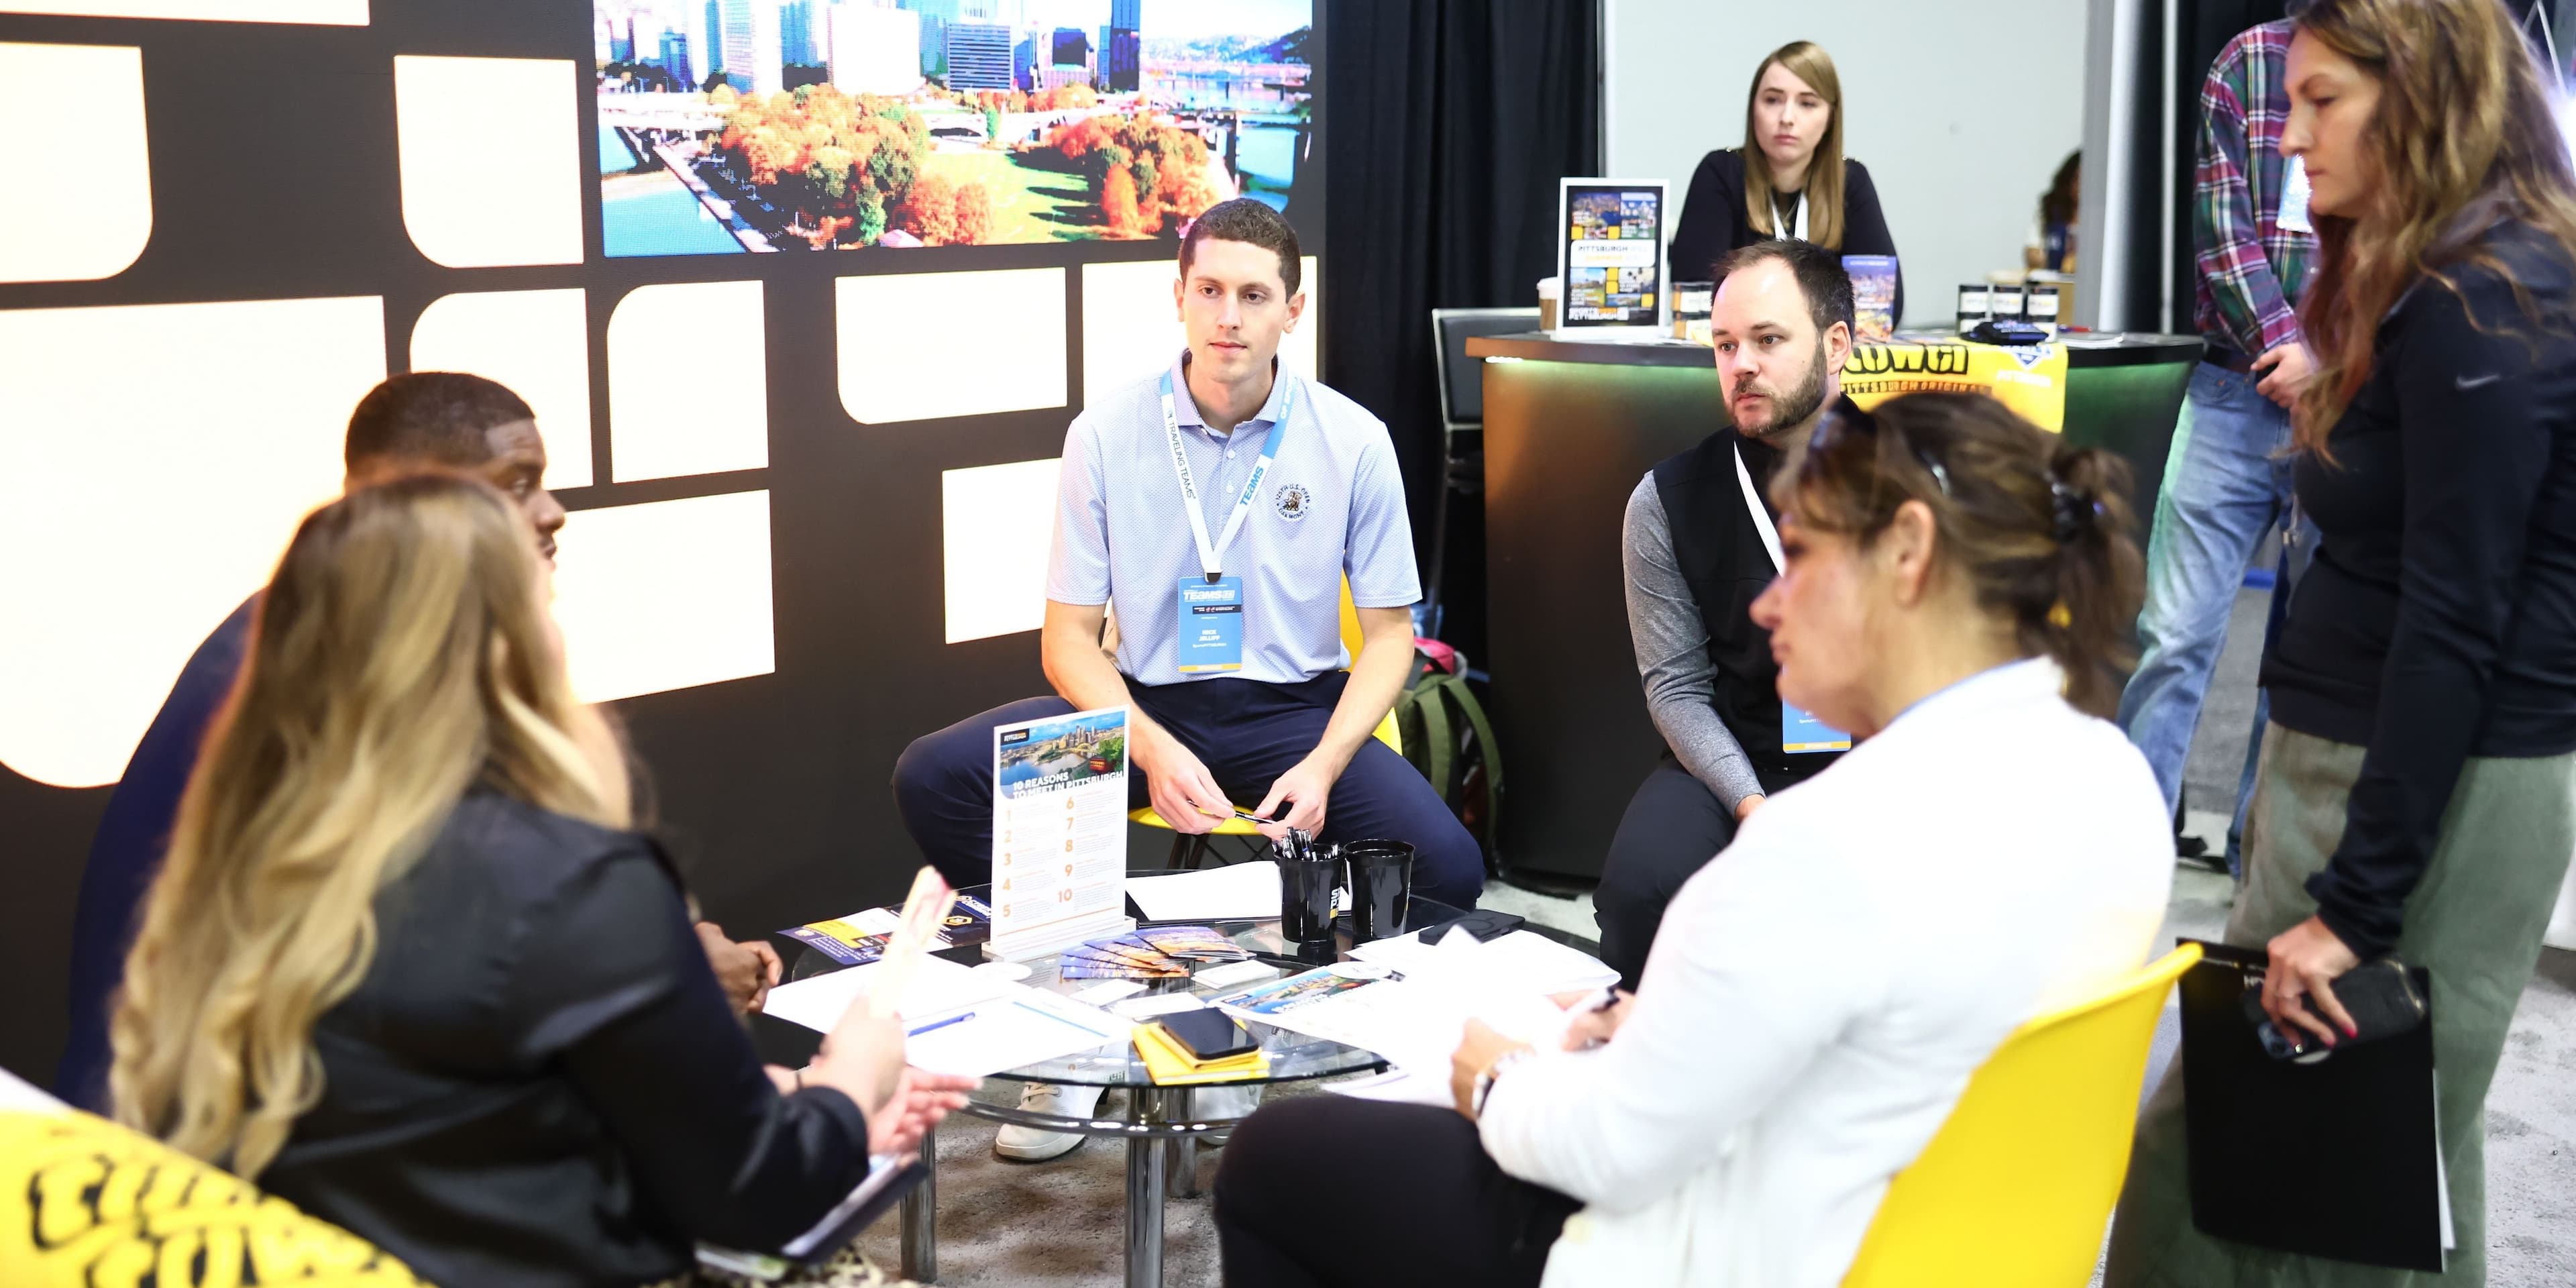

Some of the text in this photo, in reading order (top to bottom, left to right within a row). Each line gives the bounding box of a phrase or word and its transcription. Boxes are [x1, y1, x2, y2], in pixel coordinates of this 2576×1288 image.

[1169, 422, 1185, 467] TRAVELING
[1013, 771, 1069, 791] 10 REASONS
[1013, 771, 1123, 800] TO MEET IN PITTSBURGH
[1067, 796, 1075, 810] 6
[1066, 816, 1074, 830] 7
[1004, 829, 1012, 843] 2
[1065, 839, 1073, 853] 8
[1004, 853, 1012, 866] 3
[1065, 863, 1073, 877] 9
[1002, 877, 1011, 891] 4
[1058, 888, 1073, 903] 10
[1003, 904, 1011, 918] 5
